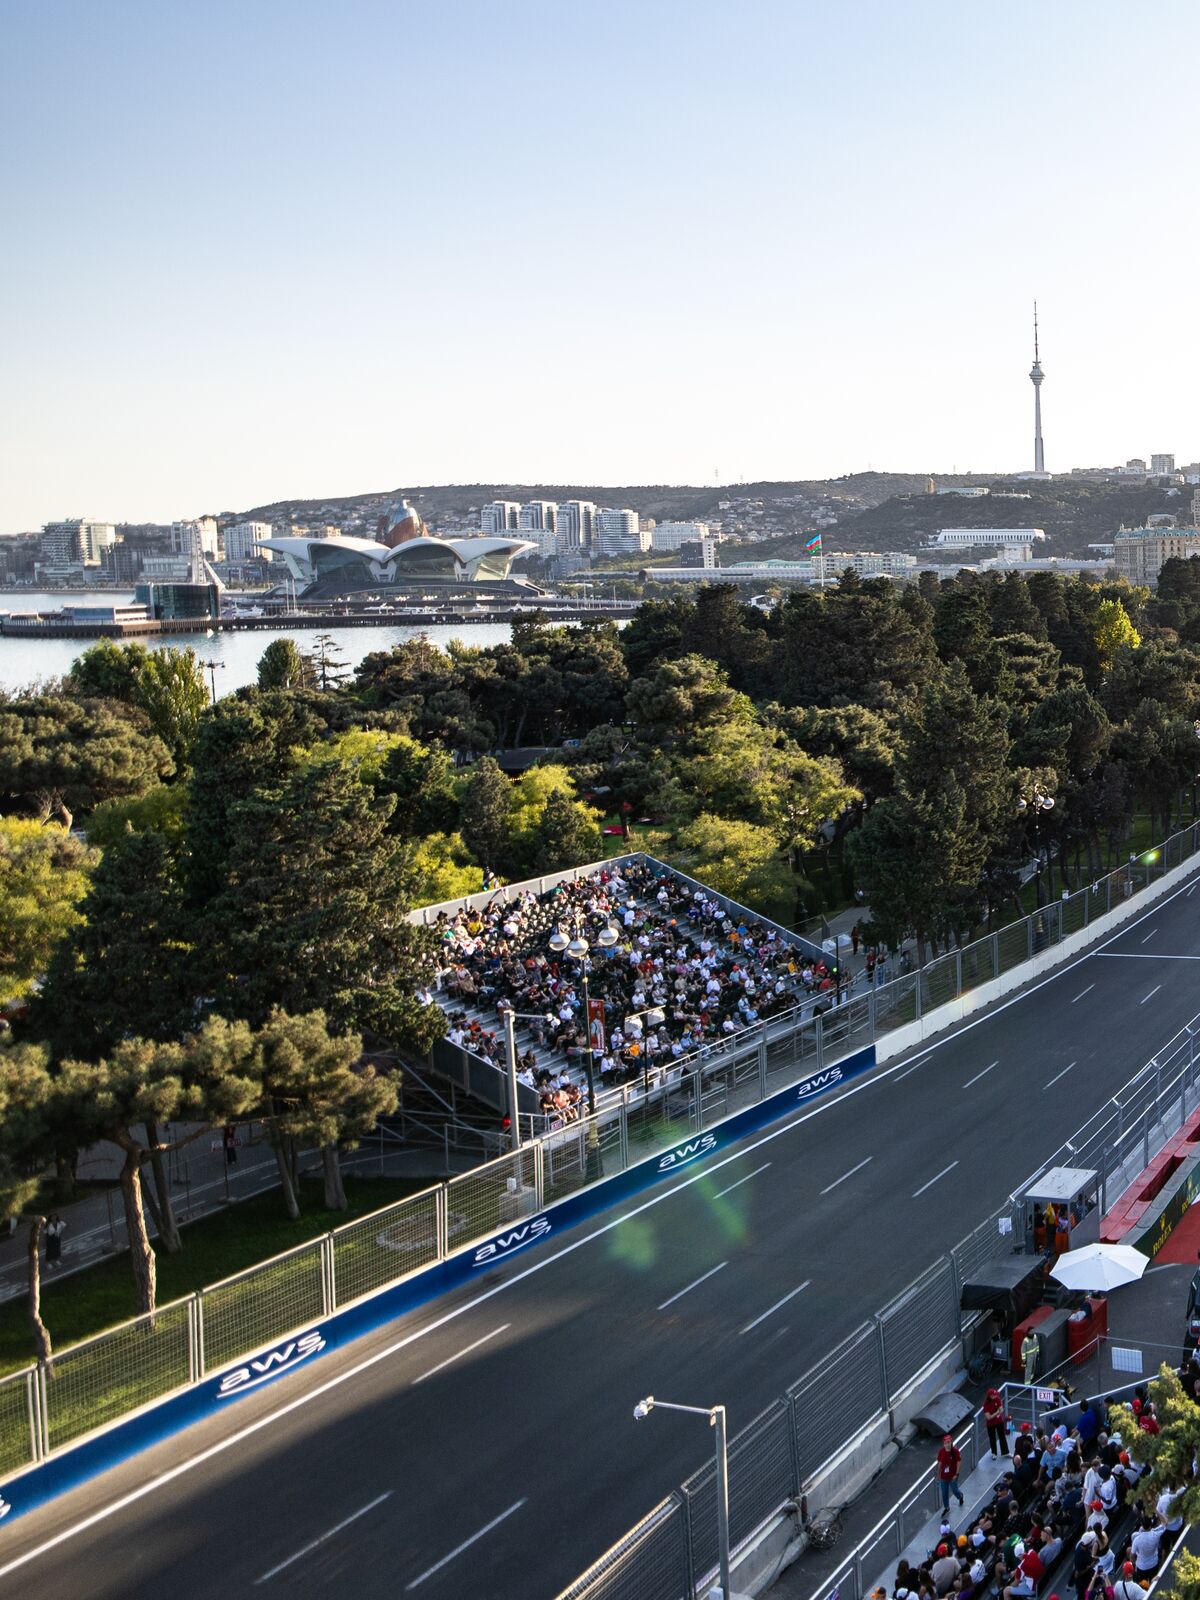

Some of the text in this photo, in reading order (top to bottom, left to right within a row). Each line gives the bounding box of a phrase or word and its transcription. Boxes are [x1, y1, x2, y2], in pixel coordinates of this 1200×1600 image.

[799, 1067, 841, 1095] aws
[659, 1133, 715, 1168] aws
[475, 1217, 549, 1261] aws
[1153, 1222, 1172, 1255] ROLEX
[220, 1331, 322, 1391] aws
[1039, 1392, 1051, 1400] EXIT
